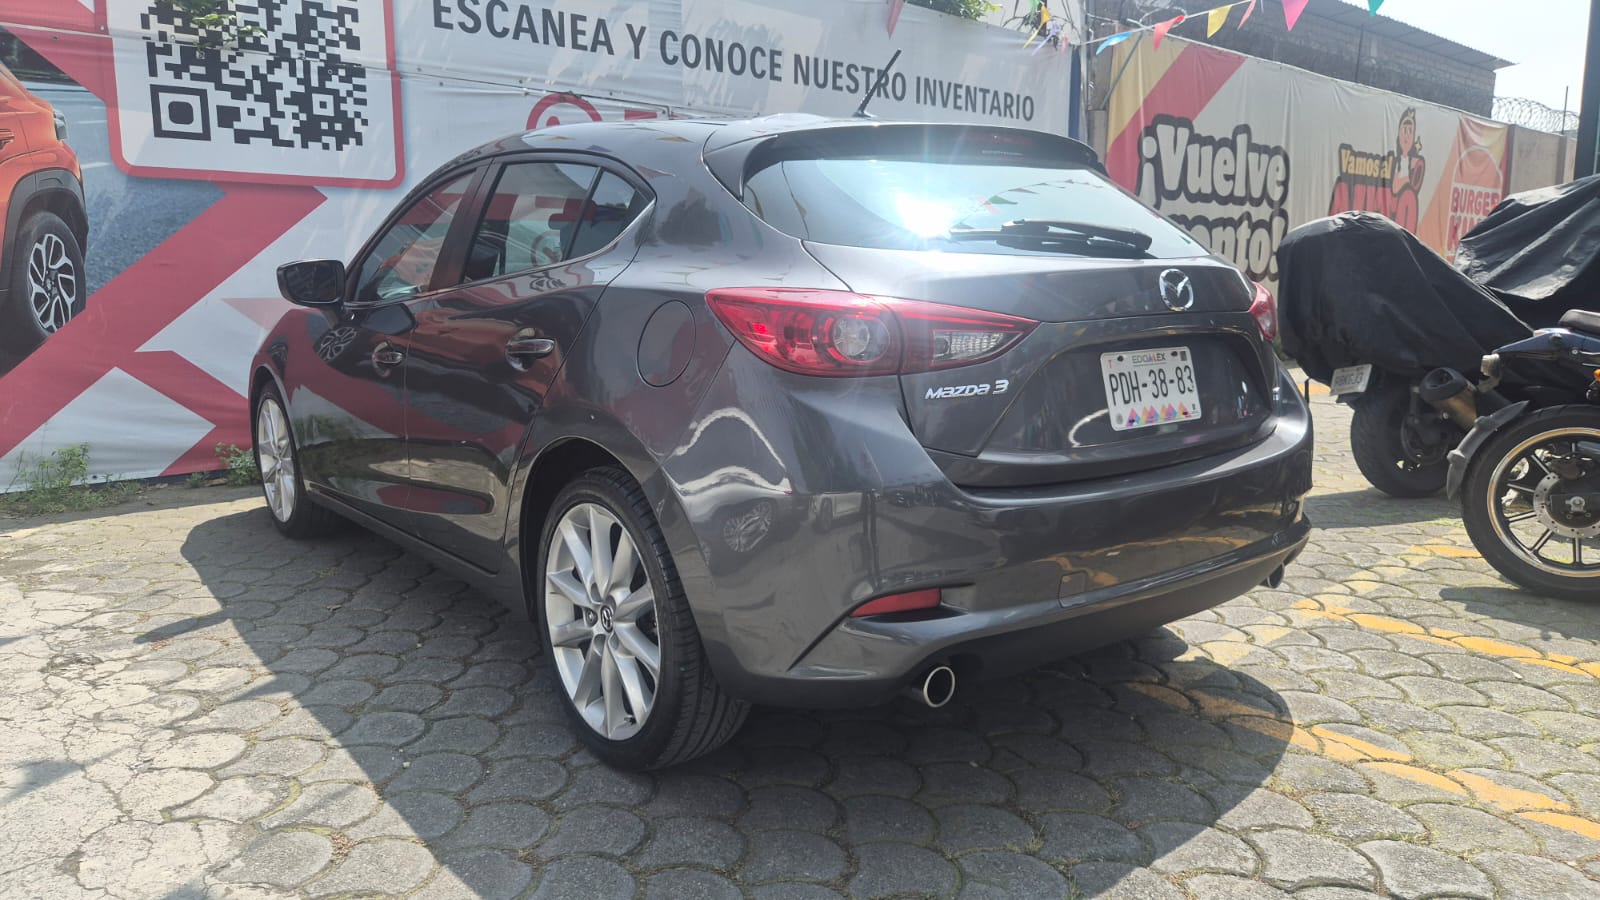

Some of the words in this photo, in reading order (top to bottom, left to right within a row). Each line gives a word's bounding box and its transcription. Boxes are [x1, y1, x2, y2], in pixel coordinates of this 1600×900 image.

[433, 0, 615, 56] ESCANEA
[625, 23, 647, 60] Y
[659, 29, 783, 83] CONOCE
[793, 53, 907, 102] NUESTRO
[915, 75, 1035, 122] INVENTARIO
[1341, 148, 1379, 178] Vamos
[1380, 154, 1393, 179] al
[992, 379, 1010, 395] 3
[1108, 365, 1194, 406] PDH-38-83
